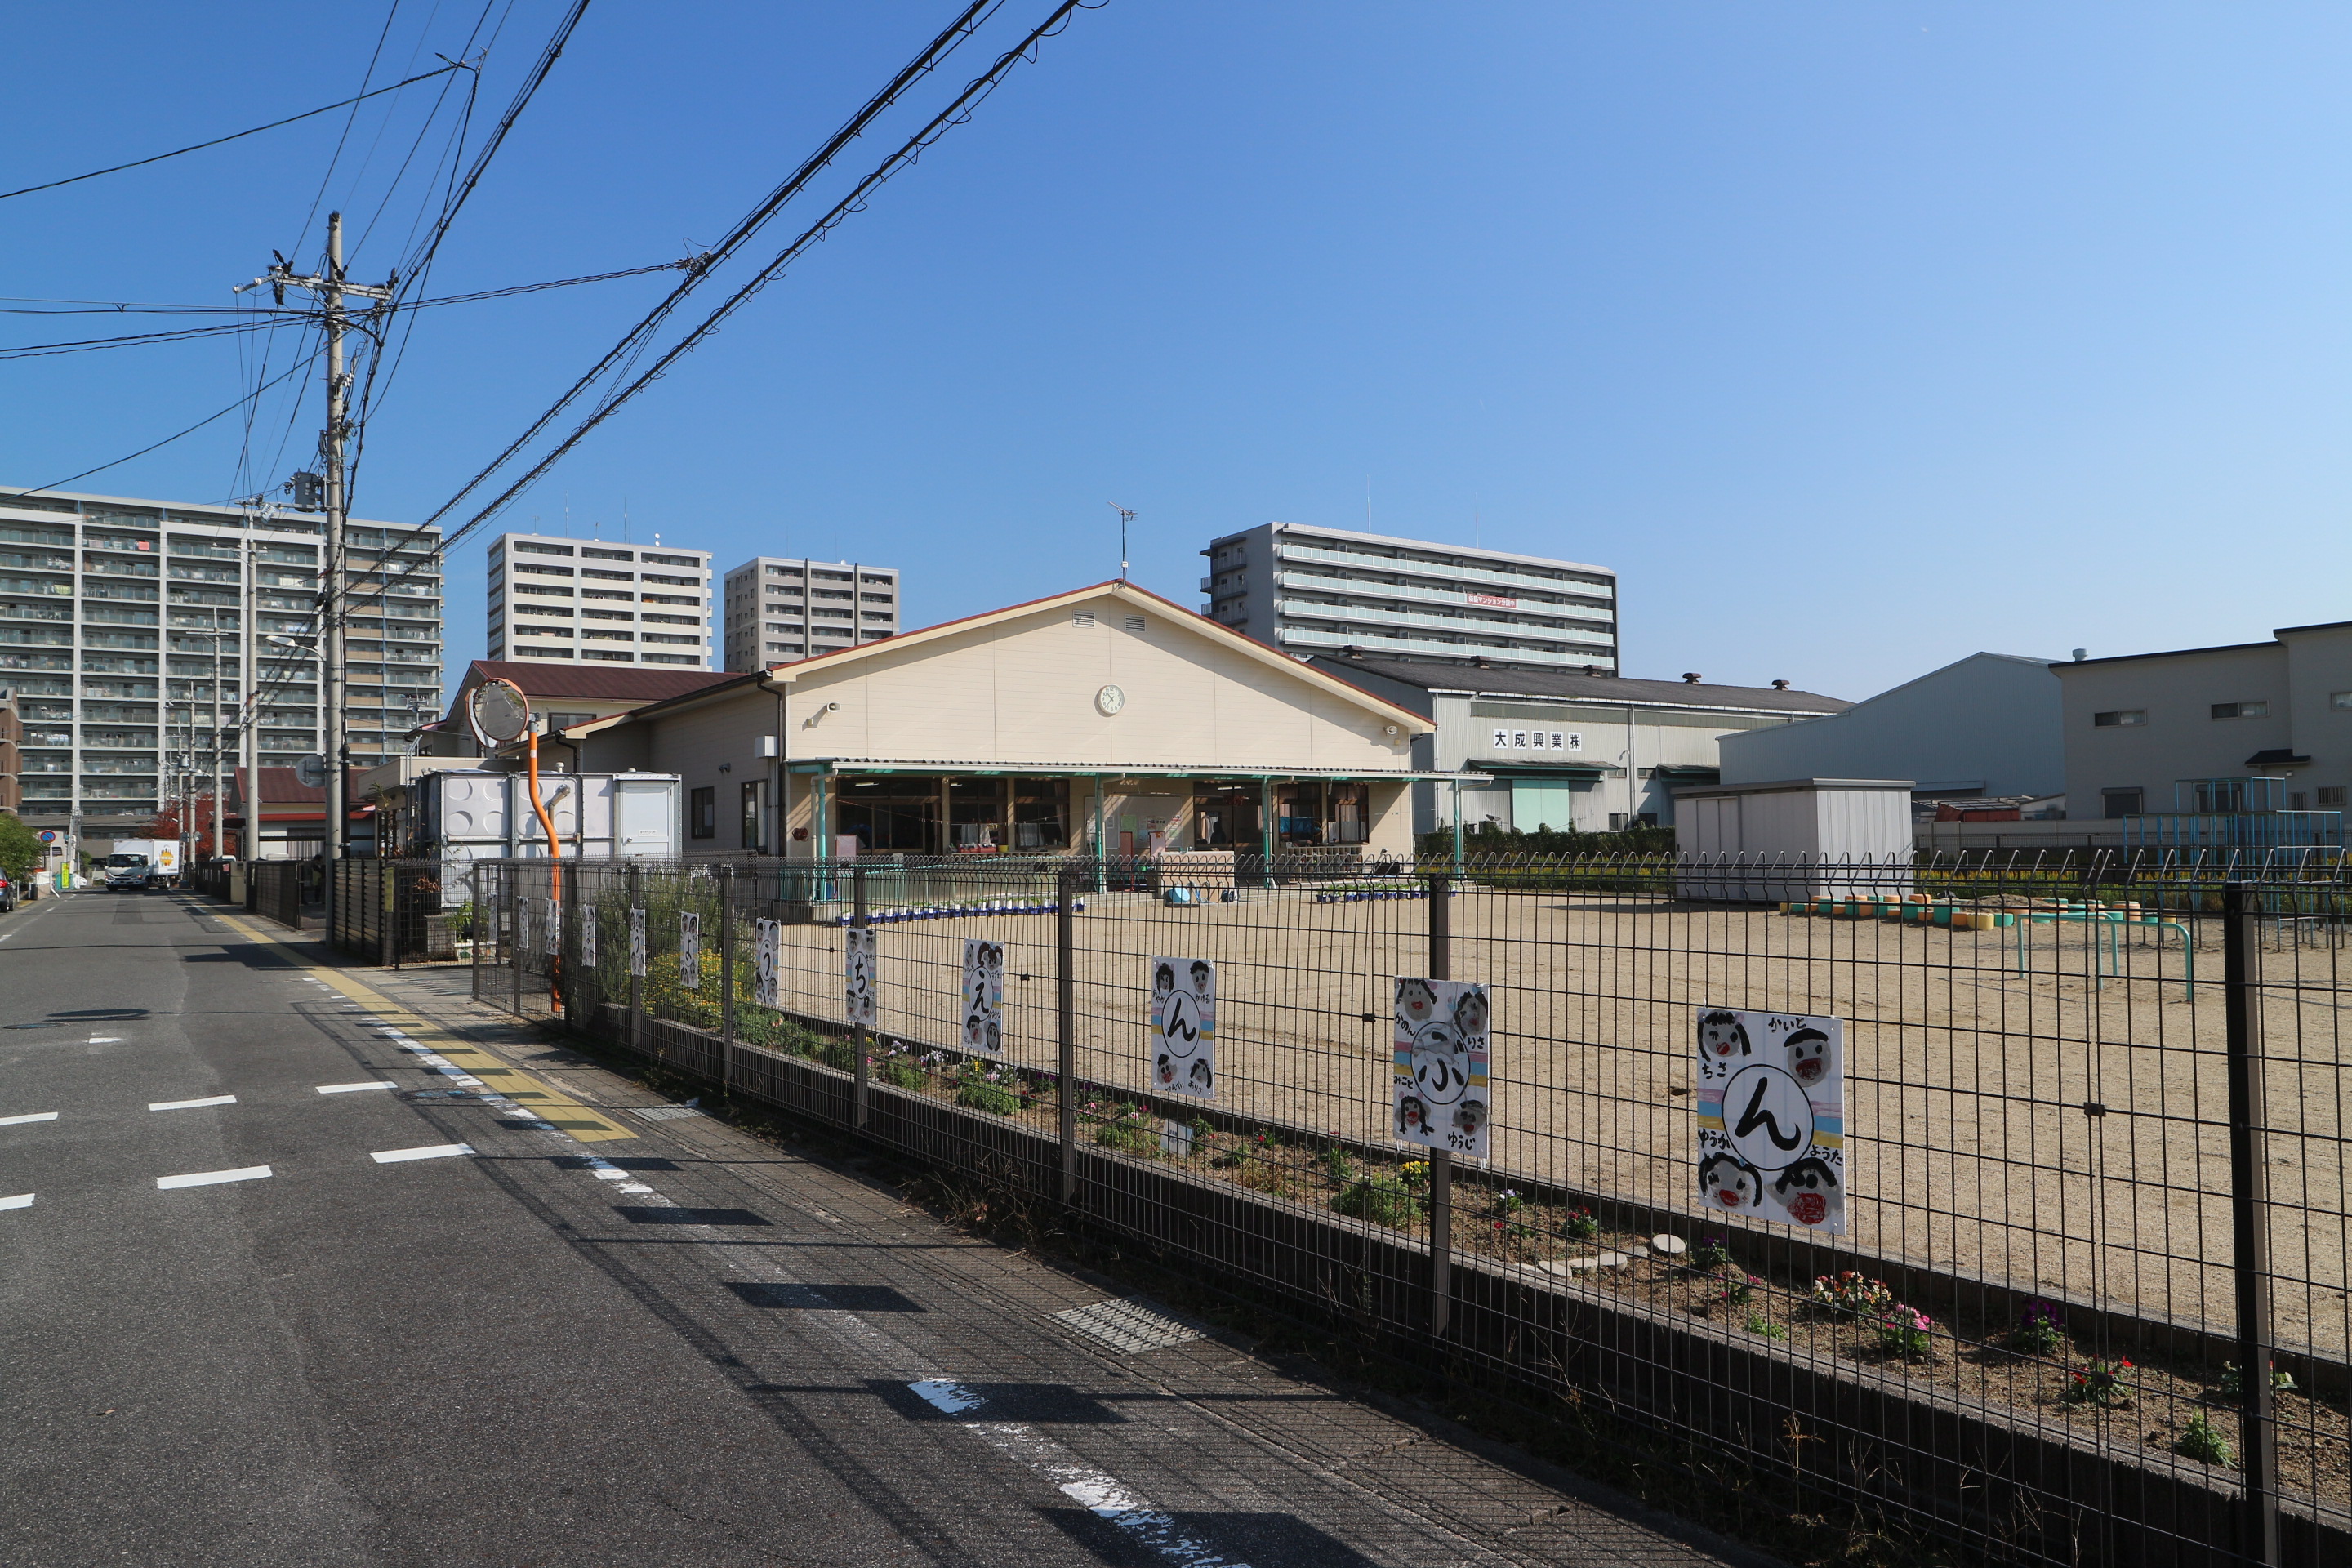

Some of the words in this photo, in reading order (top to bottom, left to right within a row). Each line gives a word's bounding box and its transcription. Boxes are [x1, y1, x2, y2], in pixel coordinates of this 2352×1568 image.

[685, 934, 693, 961] よ
[763, 943, 771, 977] う
[855, 956, 866, 994] ち
[973, 970, 990, 1014] え
[1167, 997, 1197, 1041] ん
[1395, 1011, 1416, 1036] かのん
[1768, 1016, 1807, 1033] かいと
[1467, 1036, 1485, 1050] りさ
[1702, 1062, 1727, 1080] ちさ
[1735, 1076, 1802, 1152] ん
[1447, 1130, 1476, 1151] ゆうじ
[1698, 1128, 1731, 1150] ゆうか
[1809, 1144, 1843, 1167] ようた
